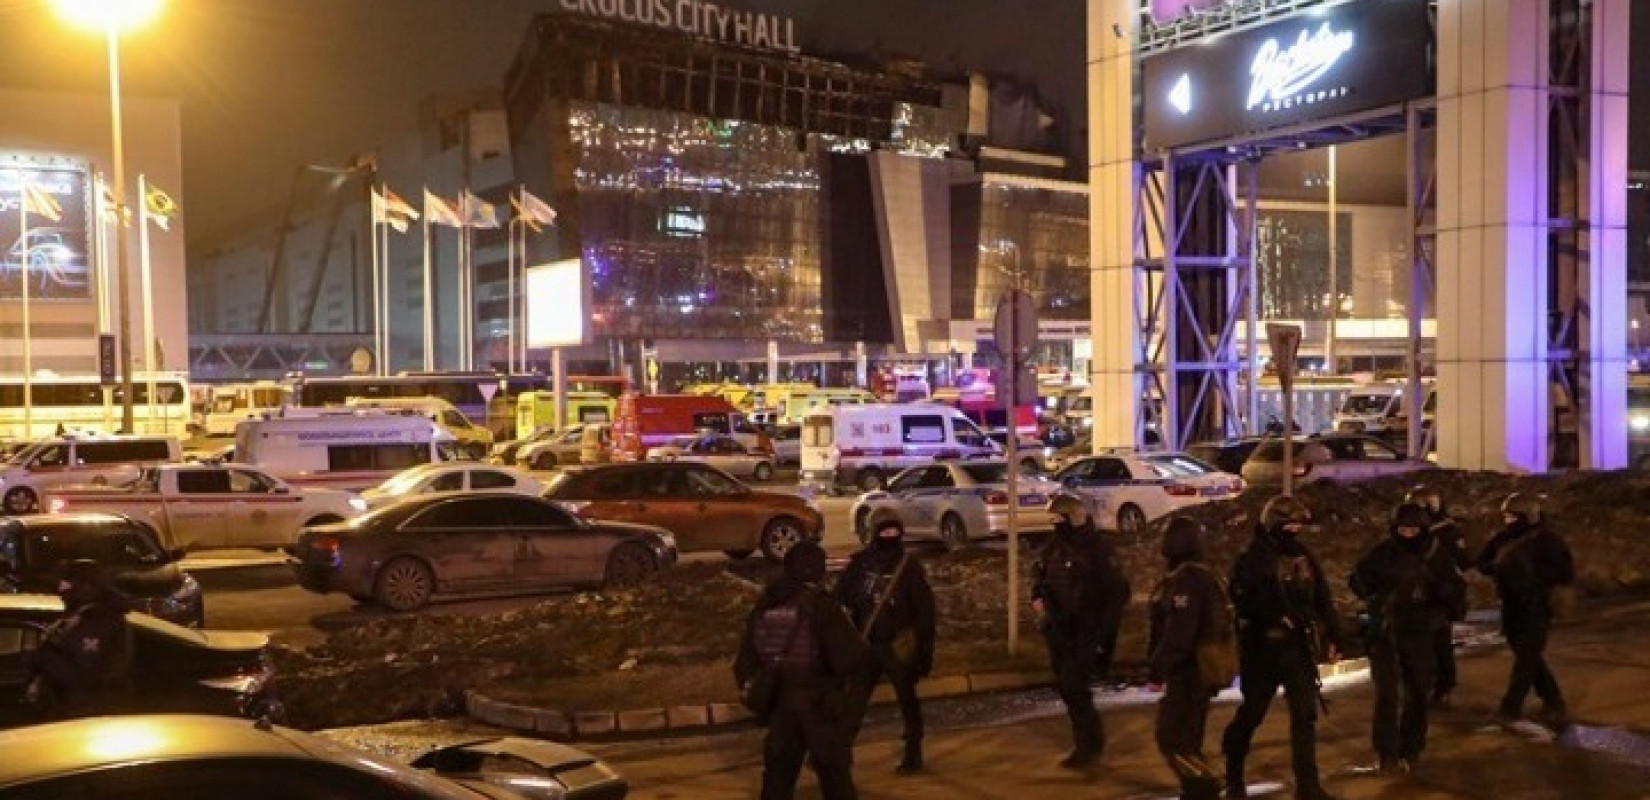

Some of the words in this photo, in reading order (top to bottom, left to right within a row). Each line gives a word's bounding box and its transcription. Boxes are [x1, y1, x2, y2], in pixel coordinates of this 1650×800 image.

[560, 0, 673, 27] OCUS
[676, 0, 730, 40] CITY
[735, 14, 801, 51] HALL
